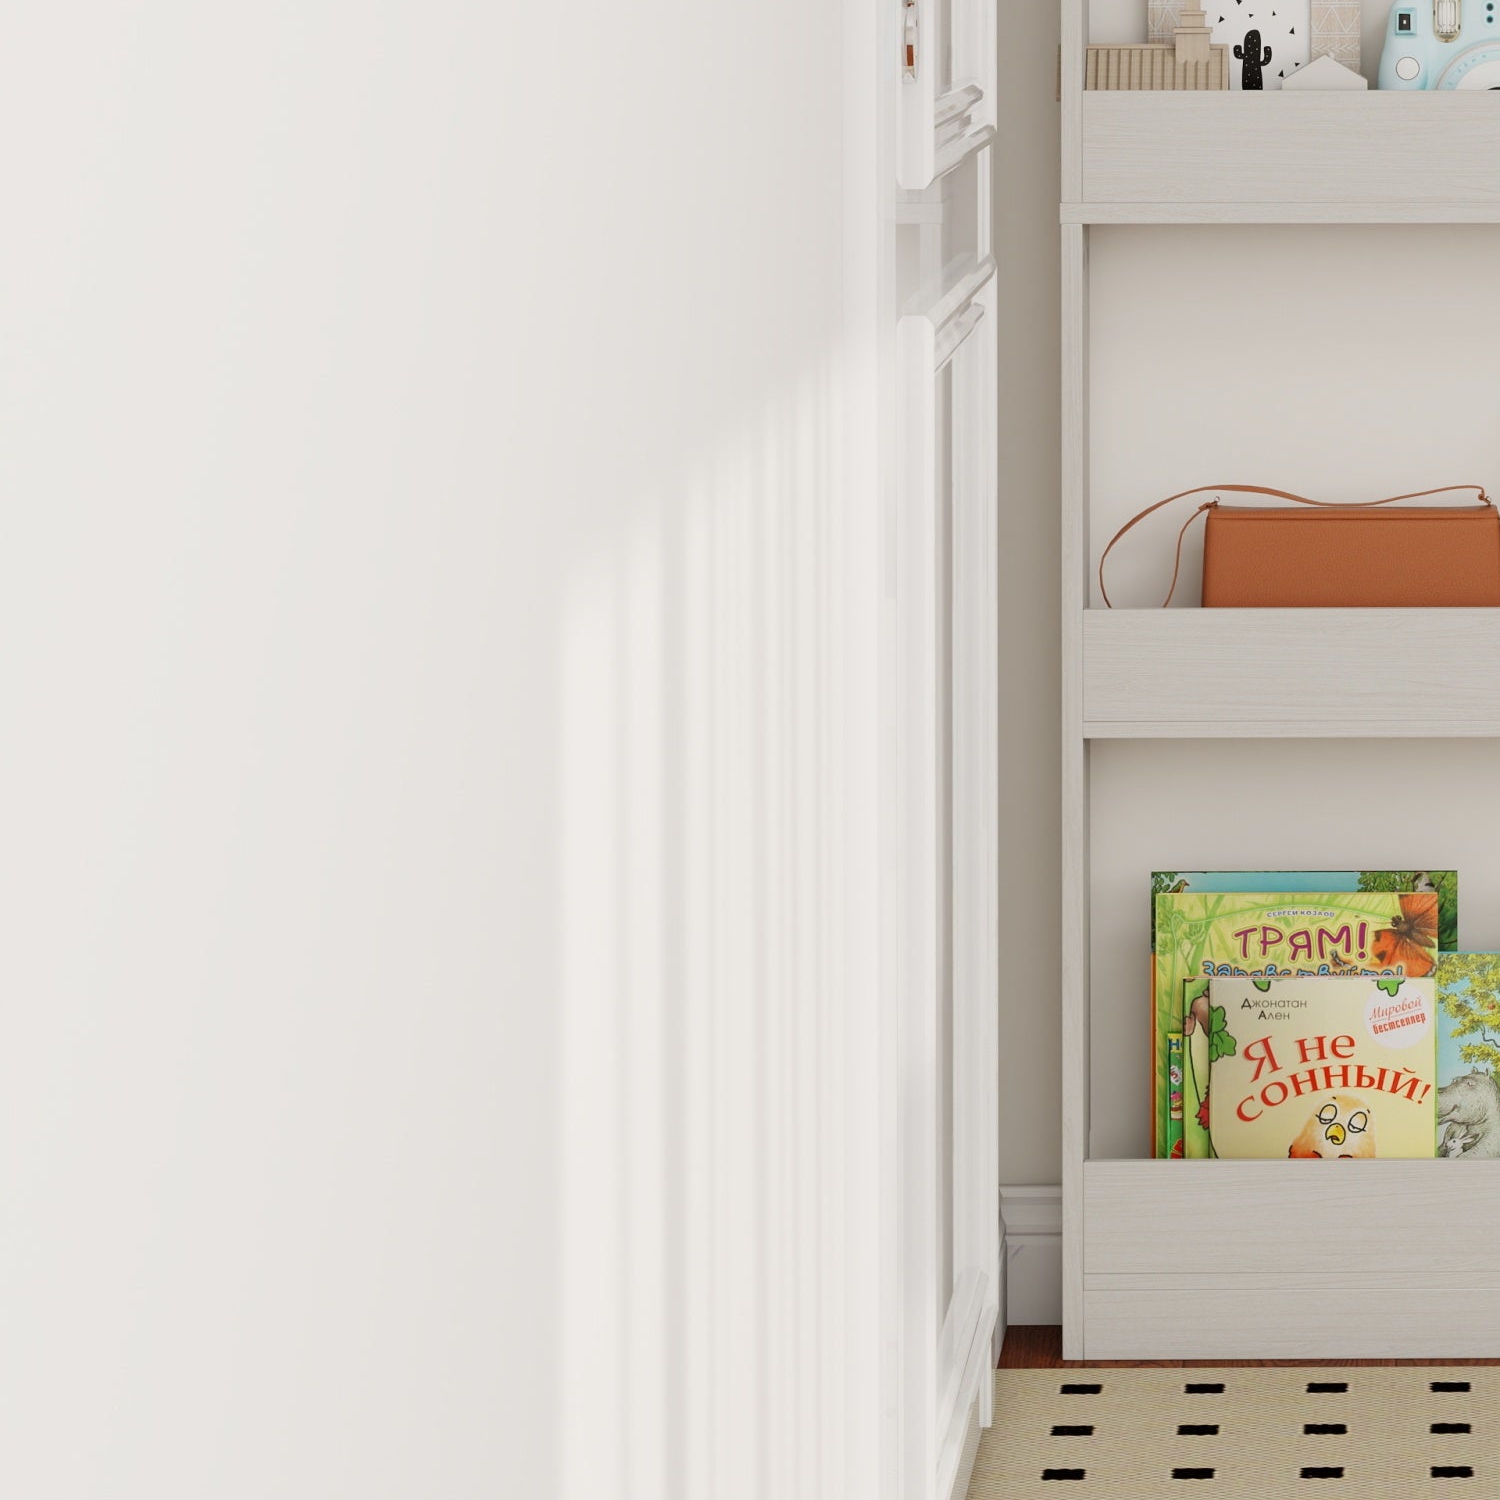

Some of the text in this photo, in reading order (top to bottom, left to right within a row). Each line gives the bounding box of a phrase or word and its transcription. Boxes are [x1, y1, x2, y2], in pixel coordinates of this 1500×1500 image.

[1233, 921, 1368, 962] ТРЯМ!
[1241, 997, 1308, 1010] Джонатан
[1257, 1010, 1291, 1021] Ален
[1369, 995, 1423, 1021] Мировой
[1243, 1034, 1356, 1083] Я не
[1235, 1064, 1432, 1123] сонный!
